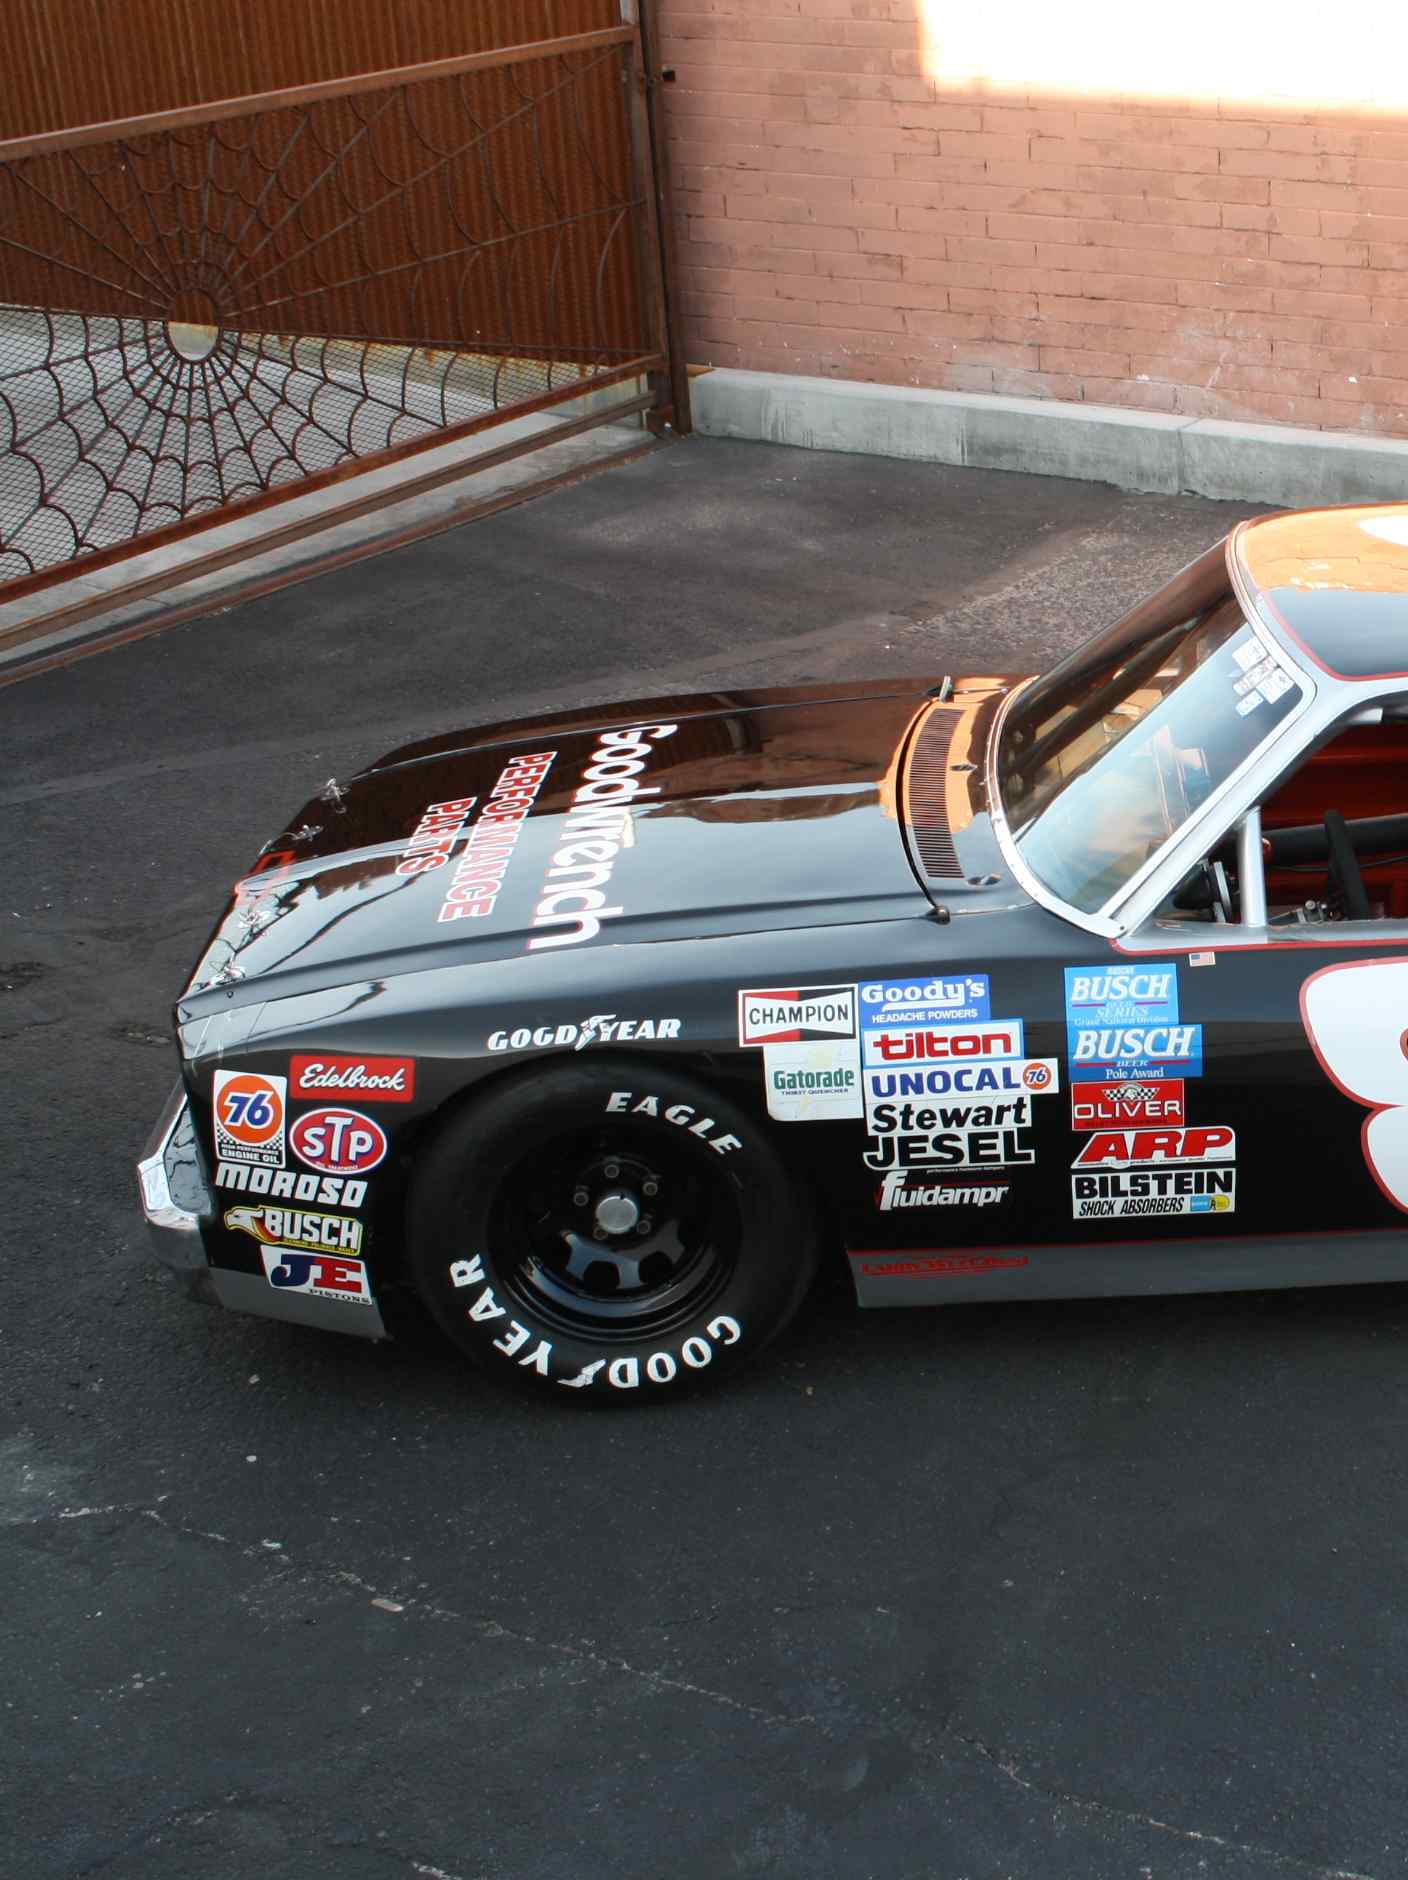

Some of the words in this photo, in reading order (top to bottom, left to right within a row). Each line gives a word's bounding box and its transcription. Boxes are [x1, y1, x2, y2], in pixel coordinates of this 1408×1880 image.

[395, 797, 477, 875] PARTS
[437, 751, 557, 922] PERFORMANCE
[527, 724, 678, 950] Goodwrench
[862, 978, 985, 1012] Goody's
[1071, 974, 1172, 1001] BUSCH
[750, 1004, 849, 1025] CHAMPION
[872, 1011, 925, 1024] HEADACHE
[928, 1009, 978, 1020] POWDERS
[1096, 1006, 1149, 1017] SERIES
[873, 1031, 1011, 1060] tilton
[1073, 1027, 1195, 1060] BUSCH
[300, 1064, 405, 1091] Edelbrock
[774, 1068, 854, 1089] Gatorade
[871, 1067, 1021, 1098] UNOCAL
[1026, 1069, 1046, 1085] 76
[1106, 1069, 1128, 1079] Pole
[1130, 1067, 1164, 1078] Award
[224, 1090, 273, 1129] 76
[605, 1092, 742, 1154] EAGLE
[872, 1097, 1027, 1133] Stewart
[1074, 1100, 1181, 1119] OLIVER
[302, 1116, 374, 1162] STP
[865, 1129, 1033, 1168] JESEL
[1078, 1128, 1233, 1163] ARP
[222, 1149, 260, 1161] ENGINE
[262, 1155, 280, 1164] OIL
[215, 1162, 368, 1208] MOROSO
[879, 1170, 1009, 1210] fluidampr
[1075, 1170, 1232, 1199] BILSTEIN
[1079, 1200, 1116, 1216] SHOCK
[1120, 1197, 1184, 1215] ABSORBERS
[264, 1209, 361, 1249] BUSCH
[271, 1254, 362, 1293] JE
[309, 1288, 372, 1304] PISTONS
